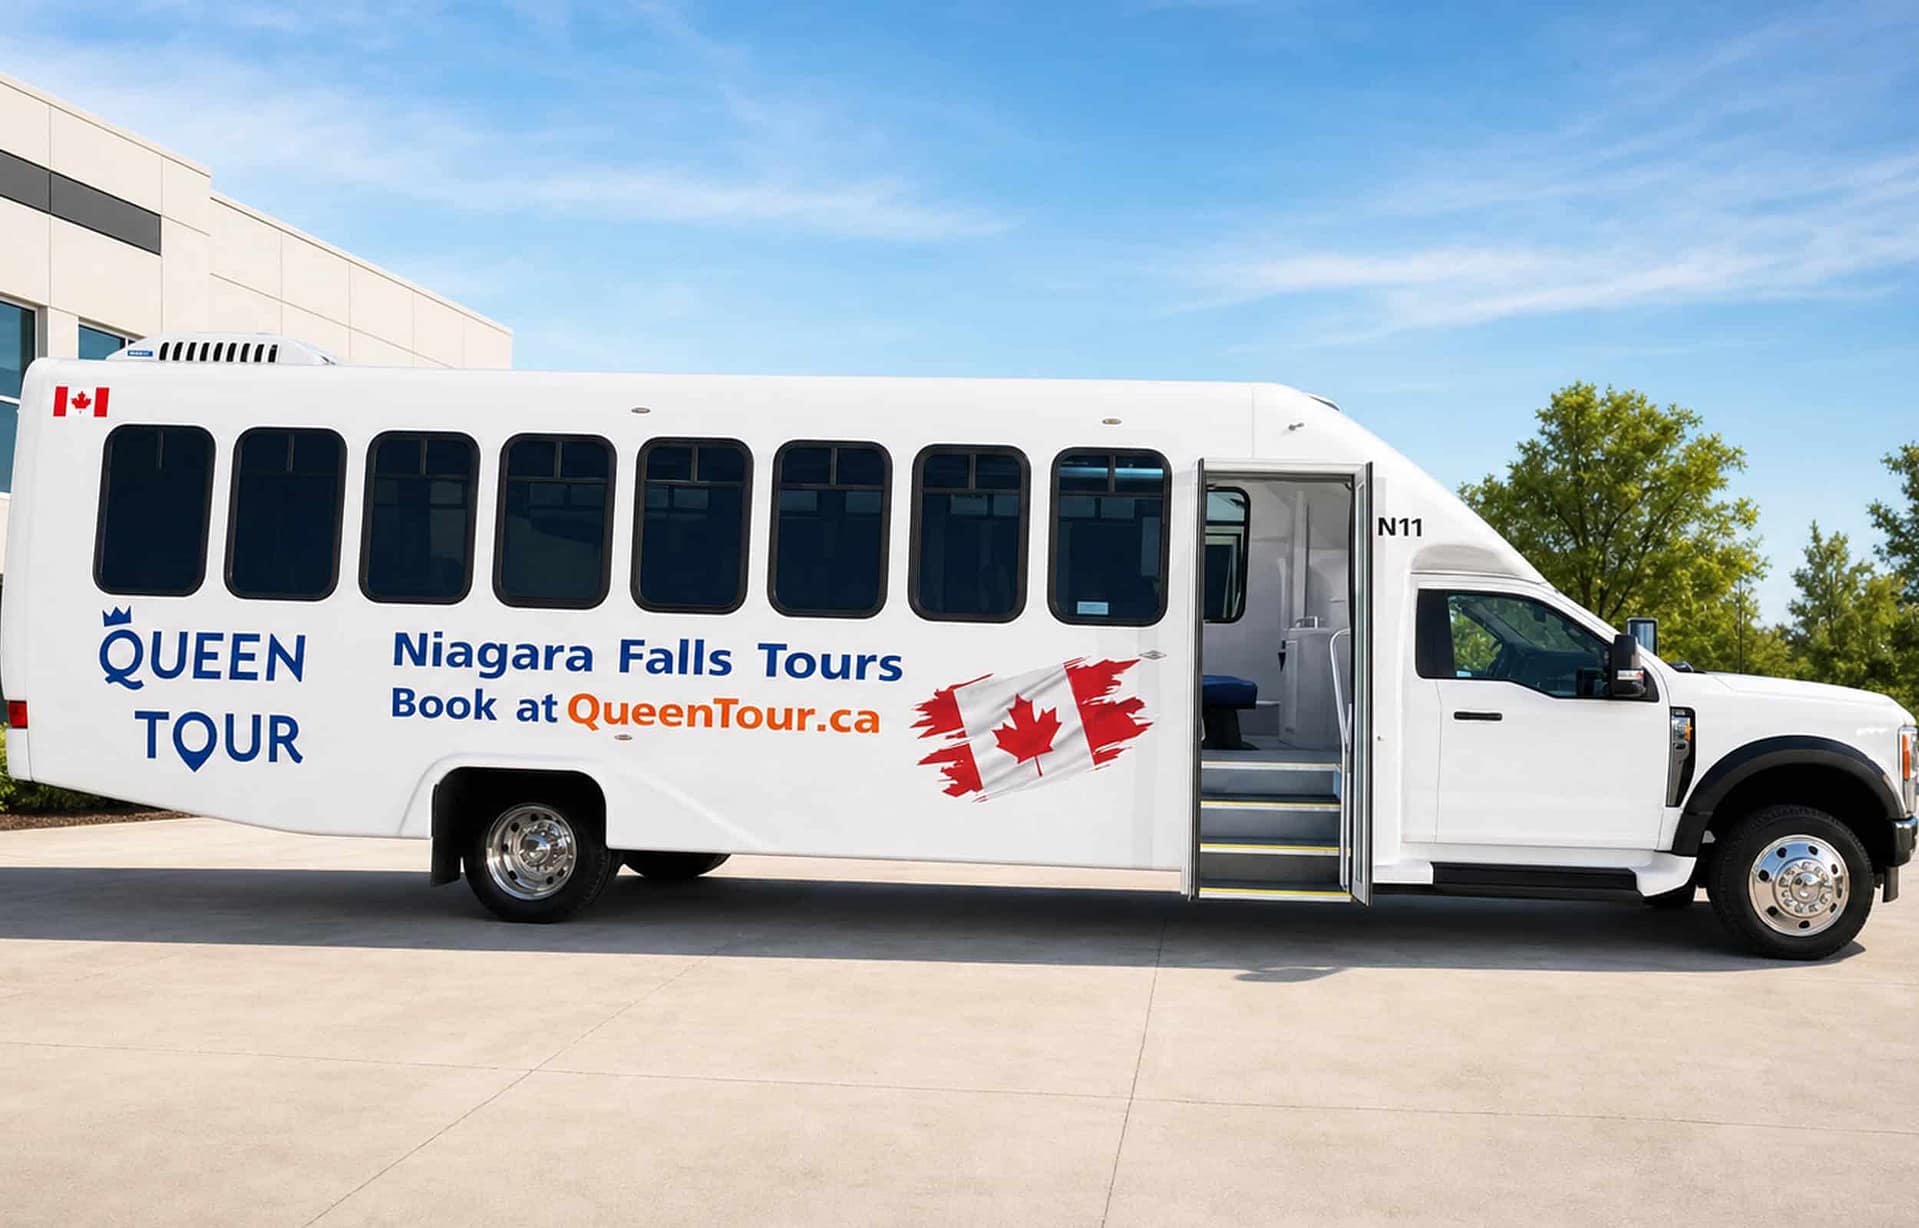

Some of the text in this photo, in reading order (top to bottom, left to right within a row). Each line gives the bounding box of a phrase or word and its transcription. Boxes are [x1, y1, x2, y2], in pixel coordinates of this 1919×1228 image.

[1377, 517, 1422, 537] N11
[99, 628, 306, 691] QUEEN
[392, 630, 903, 682] Niagara Falls Tours
[391, 686, 881, 735] Book at QueenTour.ca
[134, 710, 304, 773] TOUR
